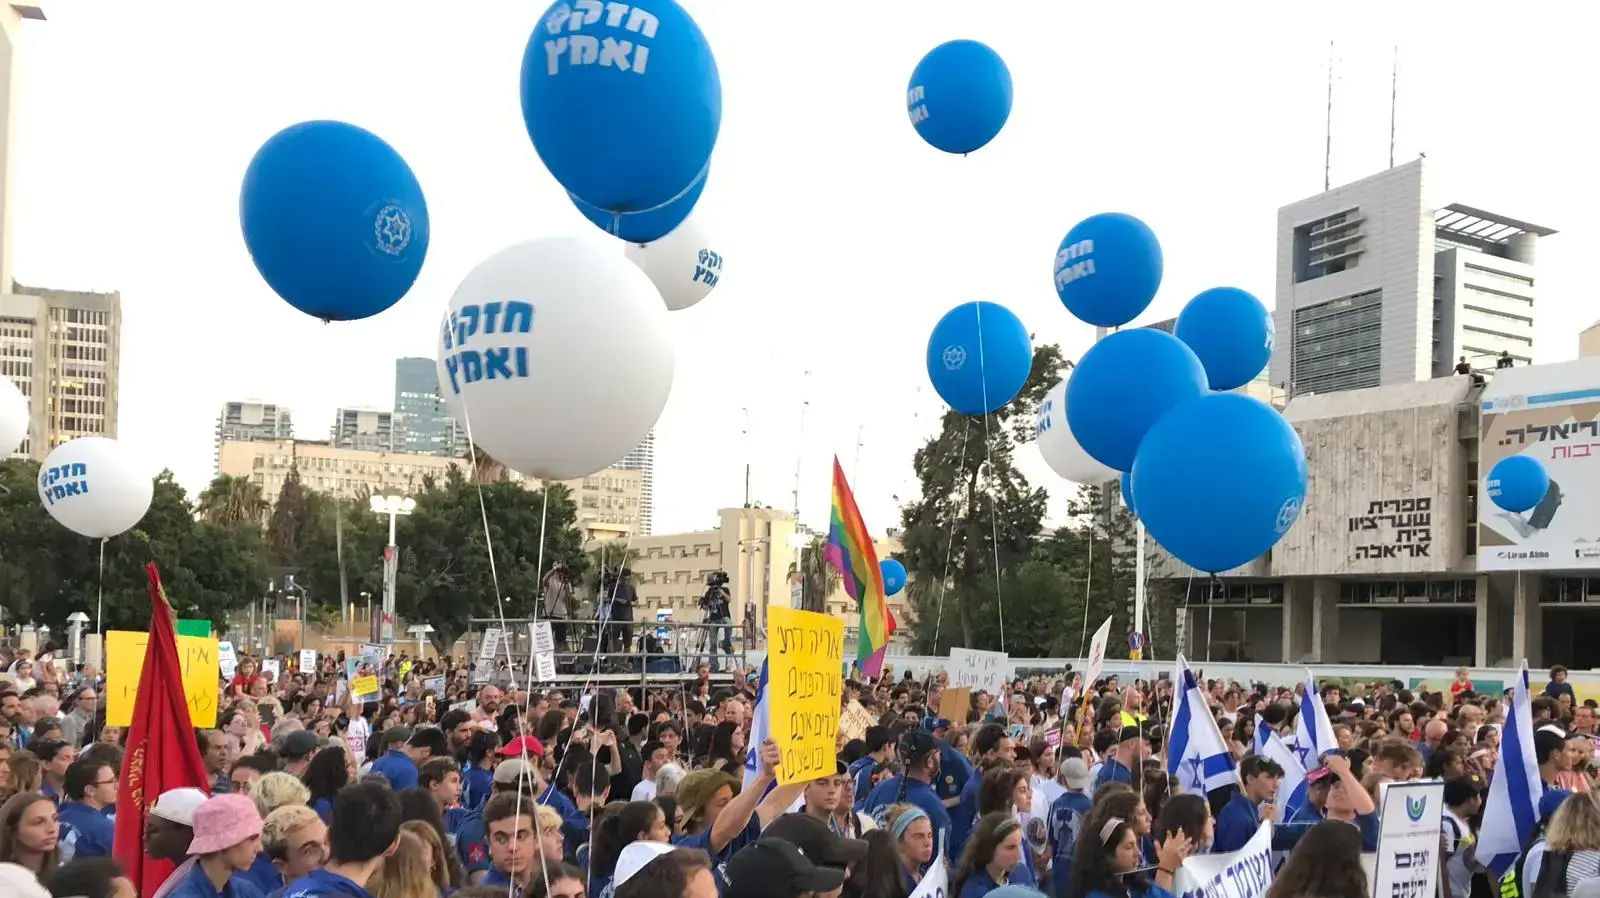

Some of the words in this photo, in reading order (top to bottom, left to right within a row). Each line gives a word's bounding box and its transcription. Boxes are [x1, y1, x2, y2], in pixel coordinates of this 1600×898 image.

[544, 35, 650, 76] ואמץ
[445, 346, 530, 395] ואמץ
[44, 480, 89, 506] ואמץ
[1368, 497, 1431, 515] ספרית
[1396, 528, 1432, 543] בית
[1355, 543, 1430, 560] אריאלה
[776, 625, 803, 655] דרעי
[808, 626, 840, 661] אריה
[788, 665, 824, 700] הפנים
[826, 670, 840, 697] שר
